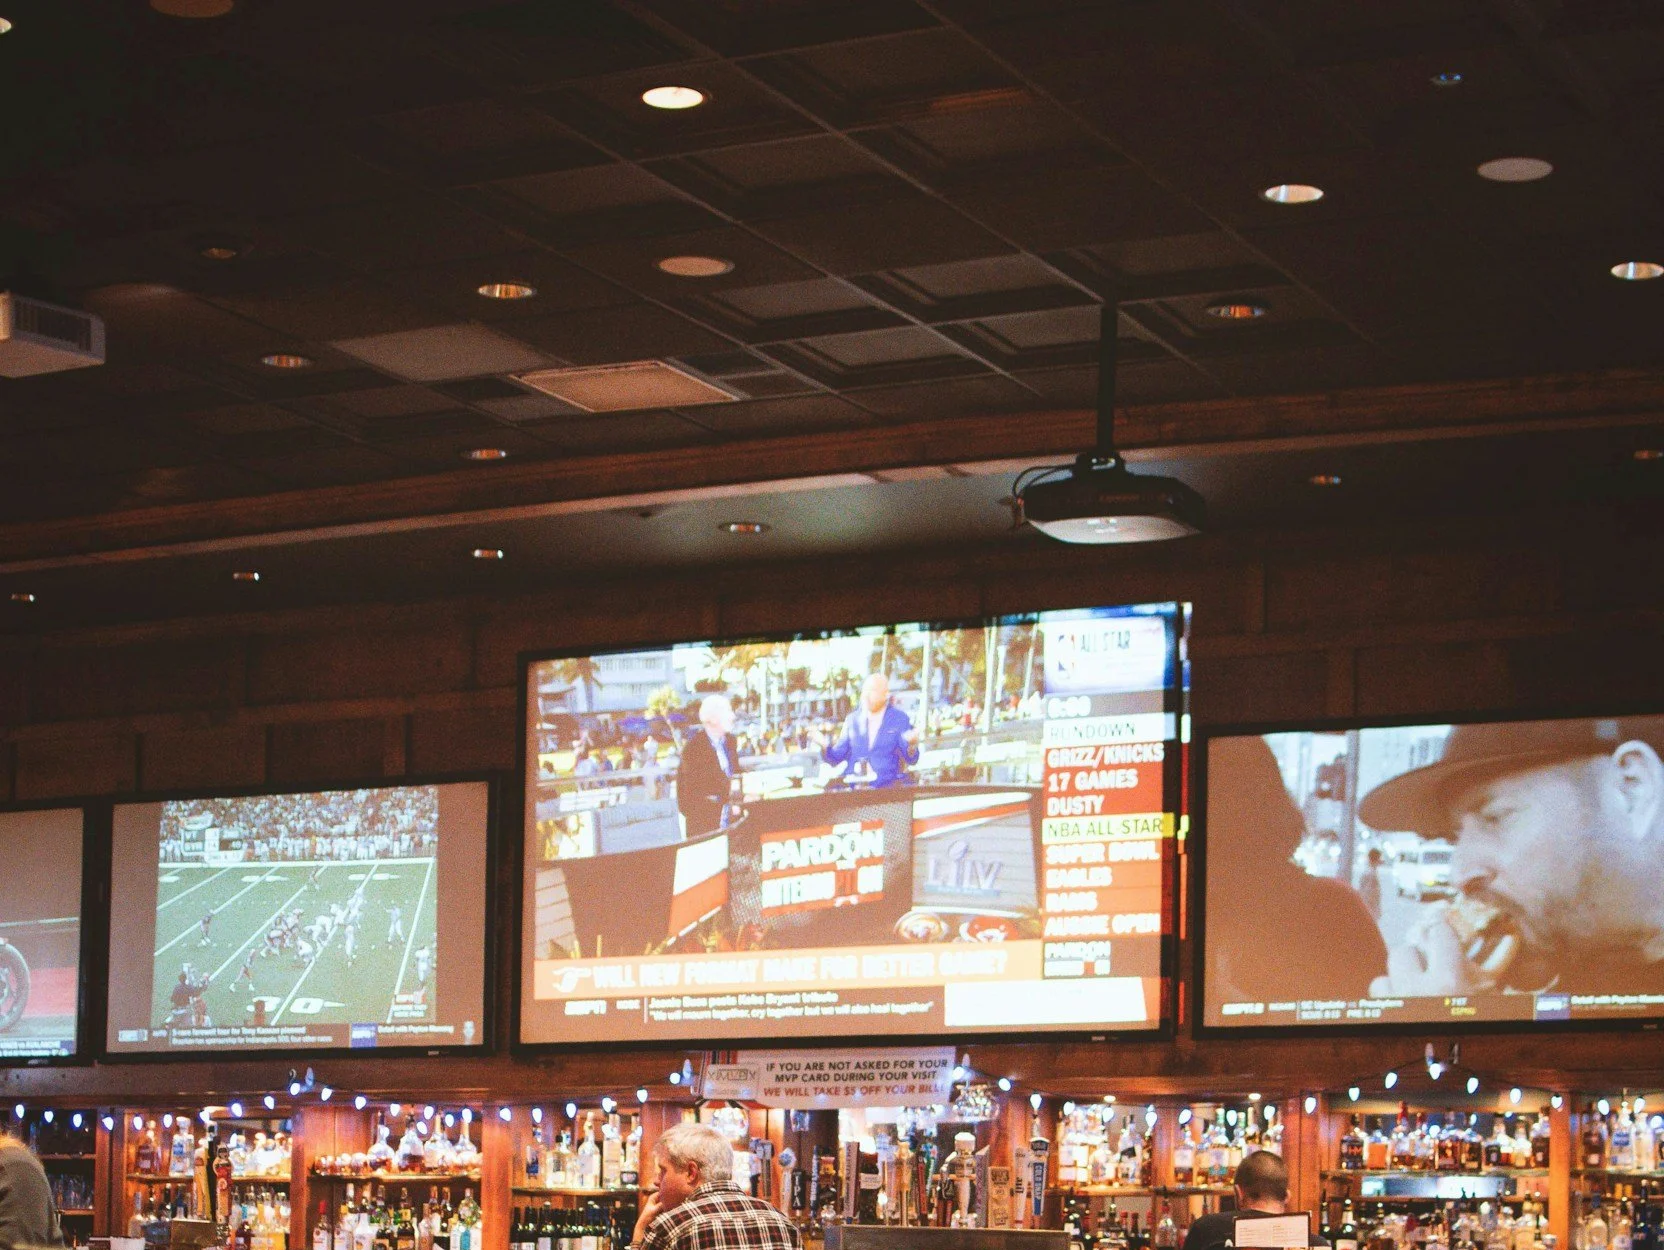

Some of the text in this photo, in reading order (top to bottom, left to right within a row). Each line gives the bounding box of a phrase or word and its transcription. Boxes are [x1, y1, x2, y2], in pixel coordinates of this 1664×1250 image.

[1049, 722, 1136, 739] RUNDOWN
[1046, 743, 1165, 768] GRIZZ/KNICKS
[1048, 769, 1138, 792] 17 GAMES
[1046, 795, 1104, 815] DUSTY
[1048, 819, 1081, 838] NBA
[761, 829, 885, 872] PARDON
[766, 1058, 947, 1072] IF YOU ARE NOT ASKED FOR YOUR
[774, 1070, 937, 1083] MVP CARD DURING YOUR VISIT
[763, 1087, 780, 1097] WE
[783, 1086, 810, 1097] WILL
[813, 1086, 841, 1096] TAKE
[844, 1086, 858, 1096] $5
[860, 1085, 881, 1096] OFF
[884, 1084, 915, 1095] YOUR
[1034, 1164, 1043, 1182] COLD
[792, 1174, 802, 1207] IPA
[1033, 1182, 1042, 1201] SNAP
